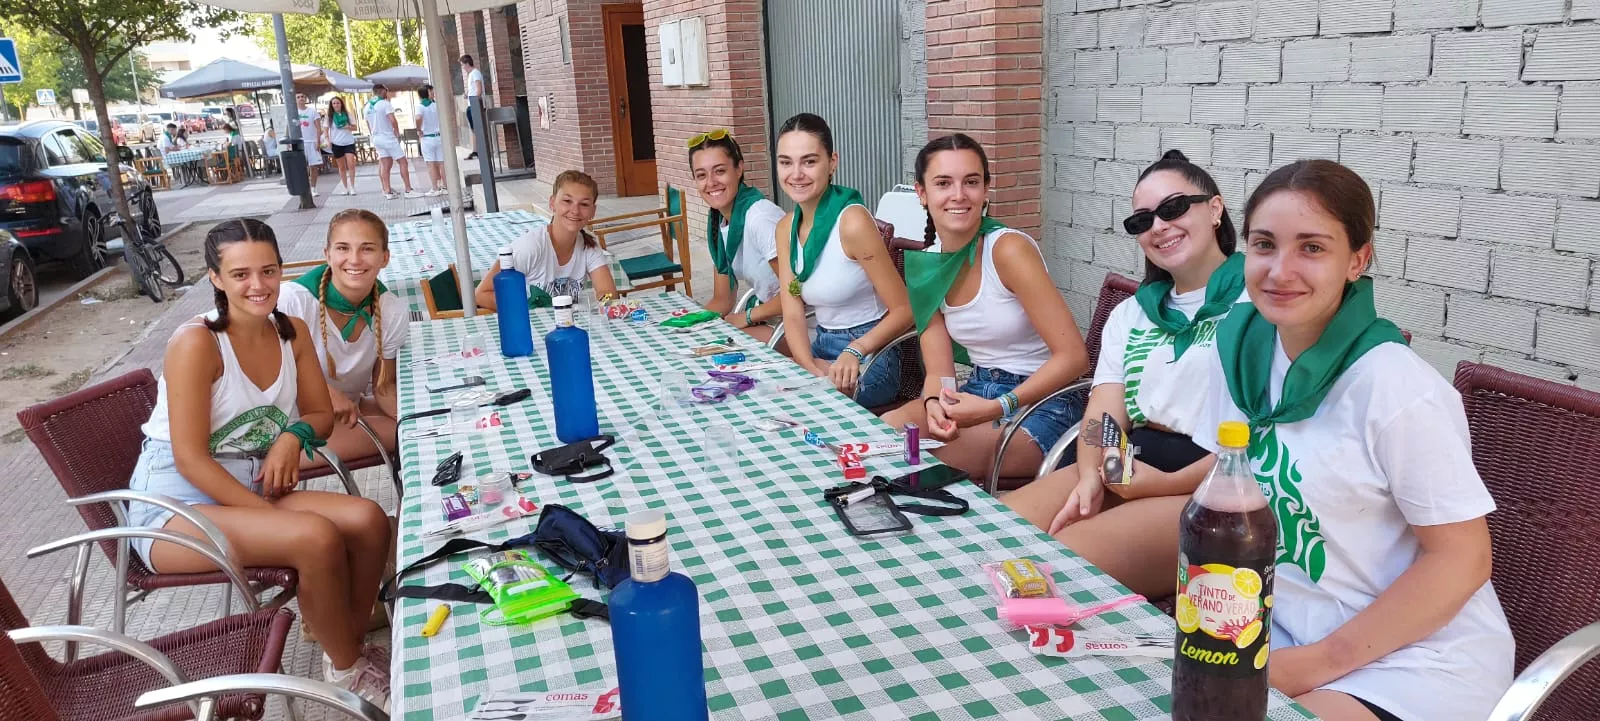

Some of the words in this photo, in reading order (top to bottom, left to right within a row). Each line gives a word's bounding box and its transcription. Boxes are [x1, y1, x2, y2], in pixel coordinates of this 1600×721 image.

[1198, 584, 1227, 600] TINTO
[1188, 592, 1223, 613] VERANO
[1085, 642, 1127, 650] comas
[1180, 637, 1239, 665] Lemon
[545, 692, 588, 701] comas
